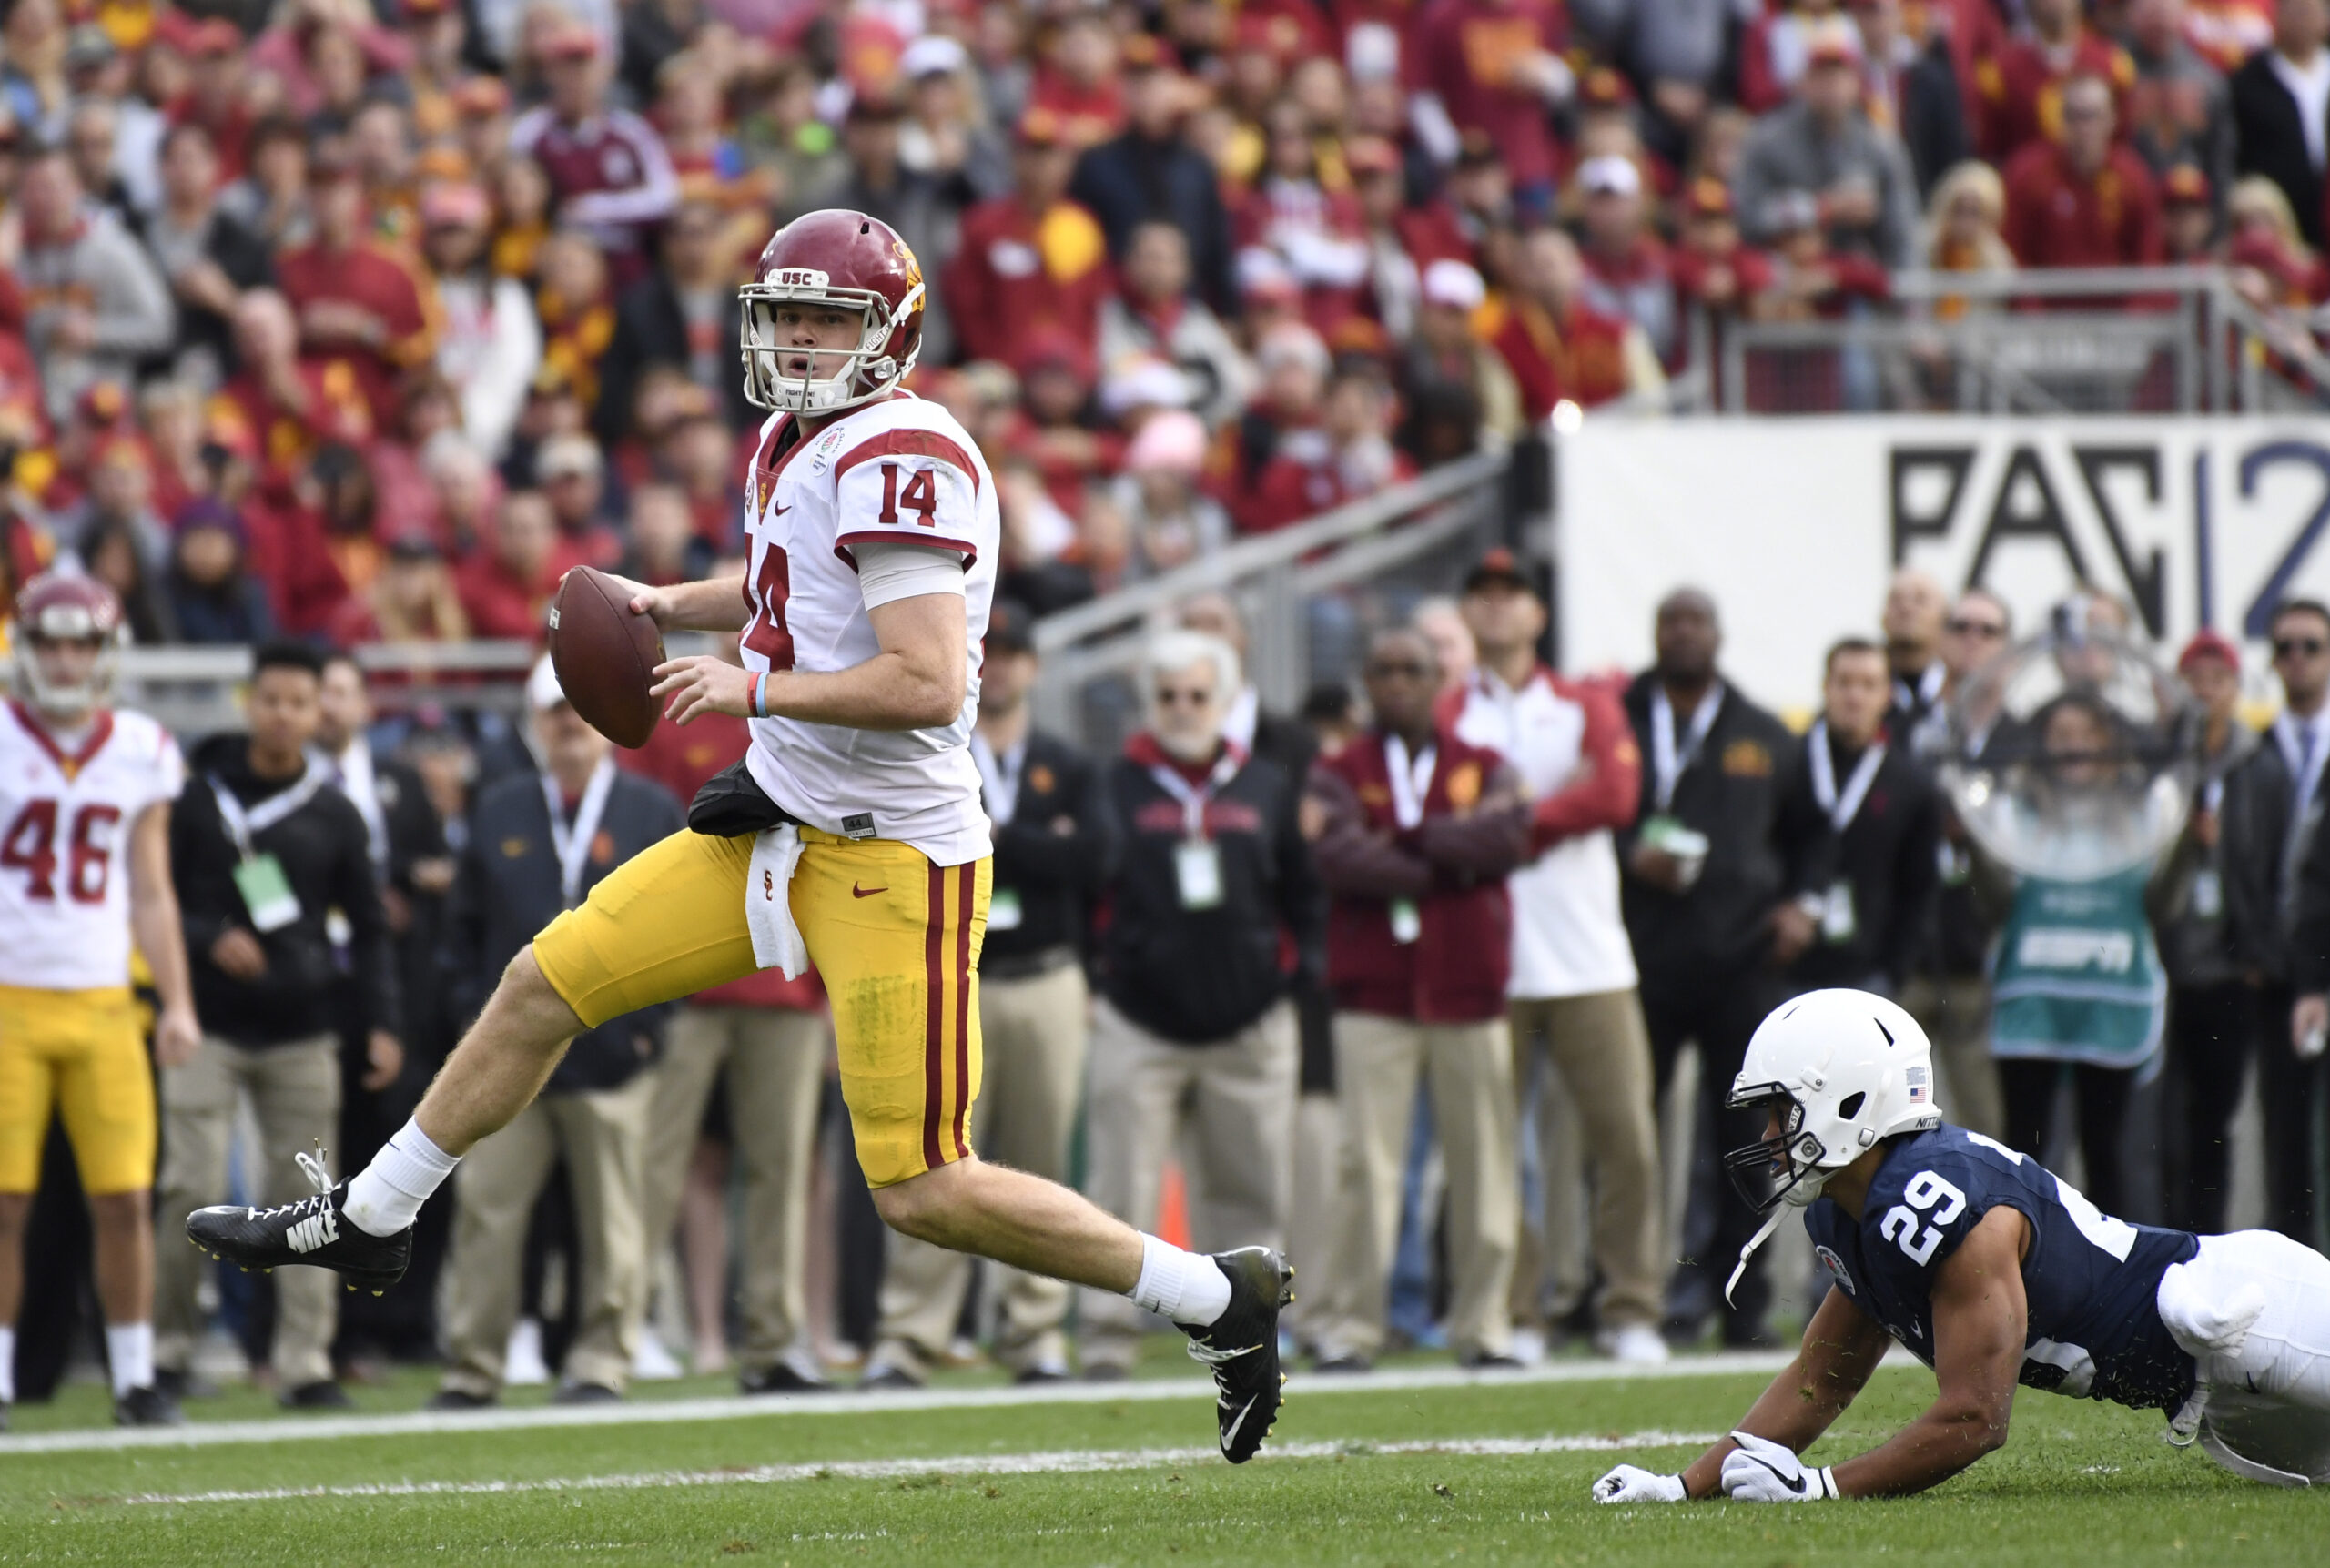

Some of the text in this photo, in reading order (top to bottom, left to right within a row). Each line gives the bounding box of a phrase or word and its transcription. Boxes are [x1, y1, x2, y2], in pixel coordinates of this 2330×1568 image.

[781, 272, 812, 286] USC
[785, 389, 803, 397] FIGHT
[878, 464, 937, 528] 14
[0, 797, 122, 905] 46
[285, 1208, 340, 1255] NIKE
[1879, 1170, 1967, 1267] 29
